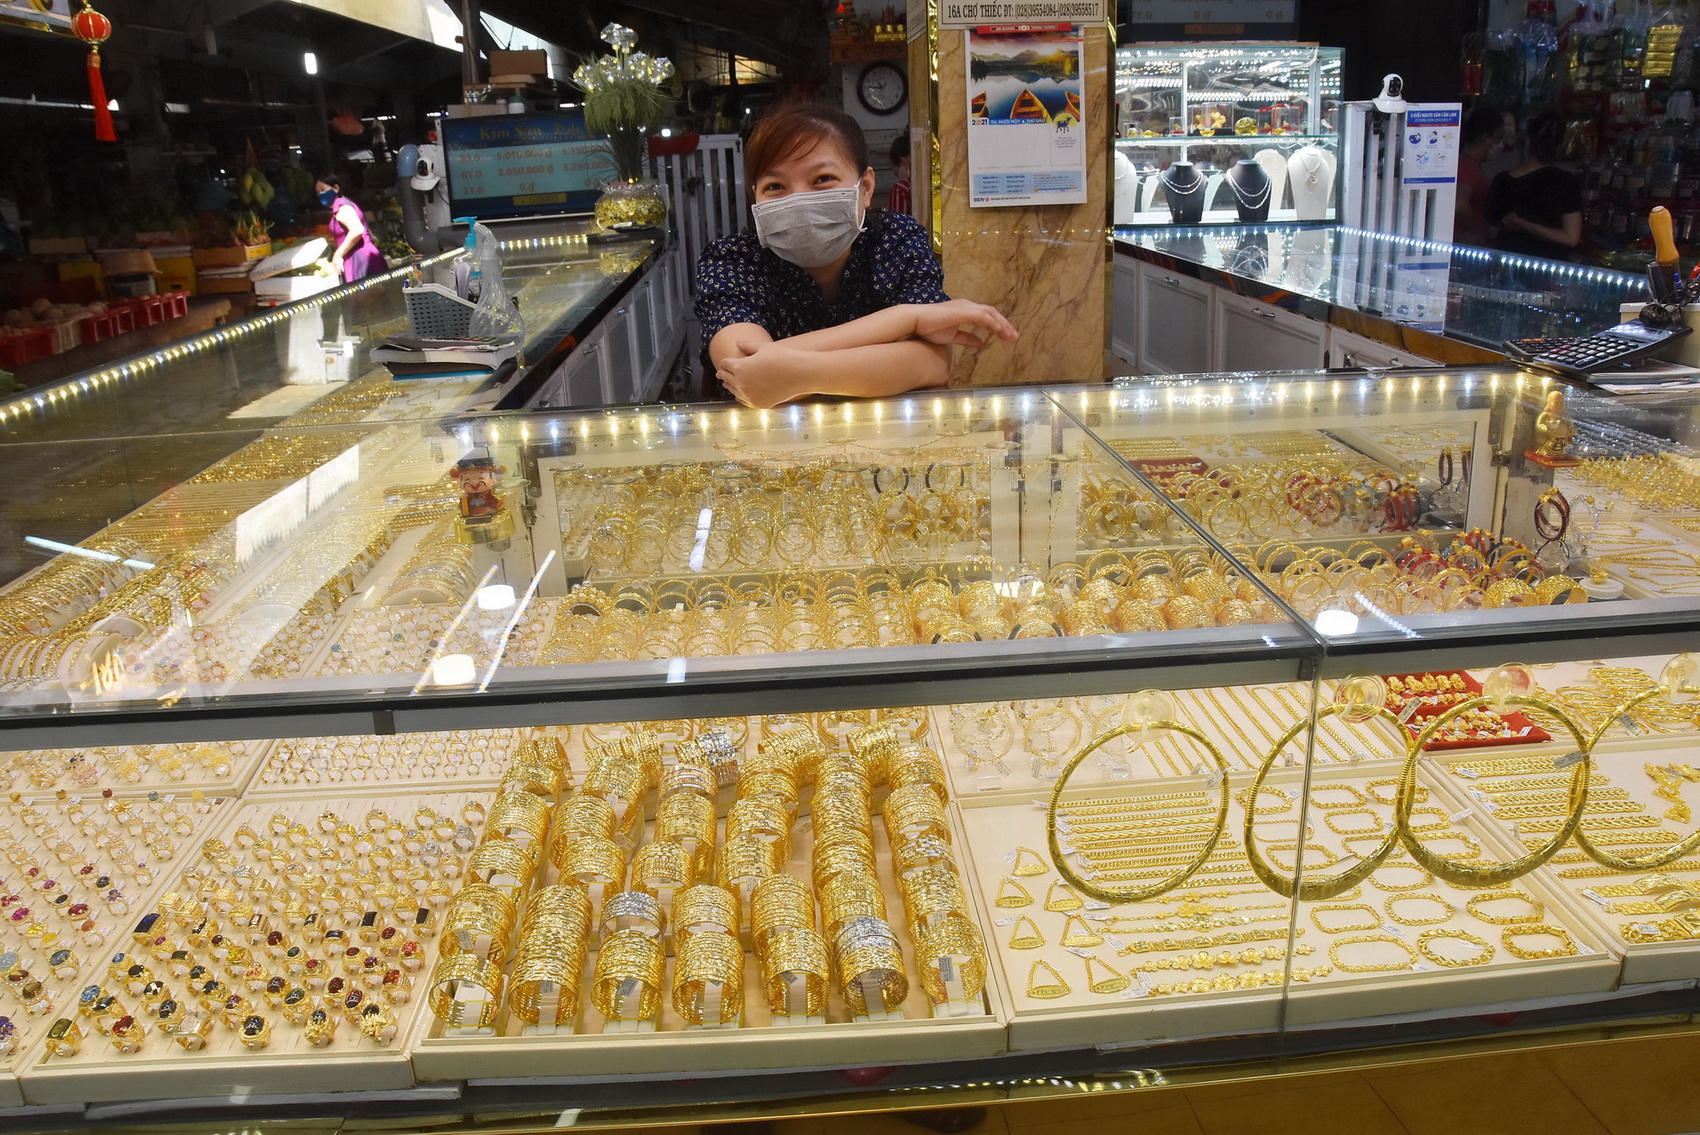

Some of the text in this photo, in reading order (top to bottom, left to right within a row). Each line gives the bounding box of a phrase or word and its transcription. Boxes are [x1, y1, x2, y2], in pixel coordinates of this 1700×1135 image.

[948, 5, 961, 18] 16A
[963, 4, 979, 20] CHỢ
[981, 0, 1003, 18] THIẾC
[1193, 10, 1201, 20] 0
[1266, 10, 1273, 20] 0
[497, 166, 544, 177] 3.050.000
[519, 183, 526, 192] 0
